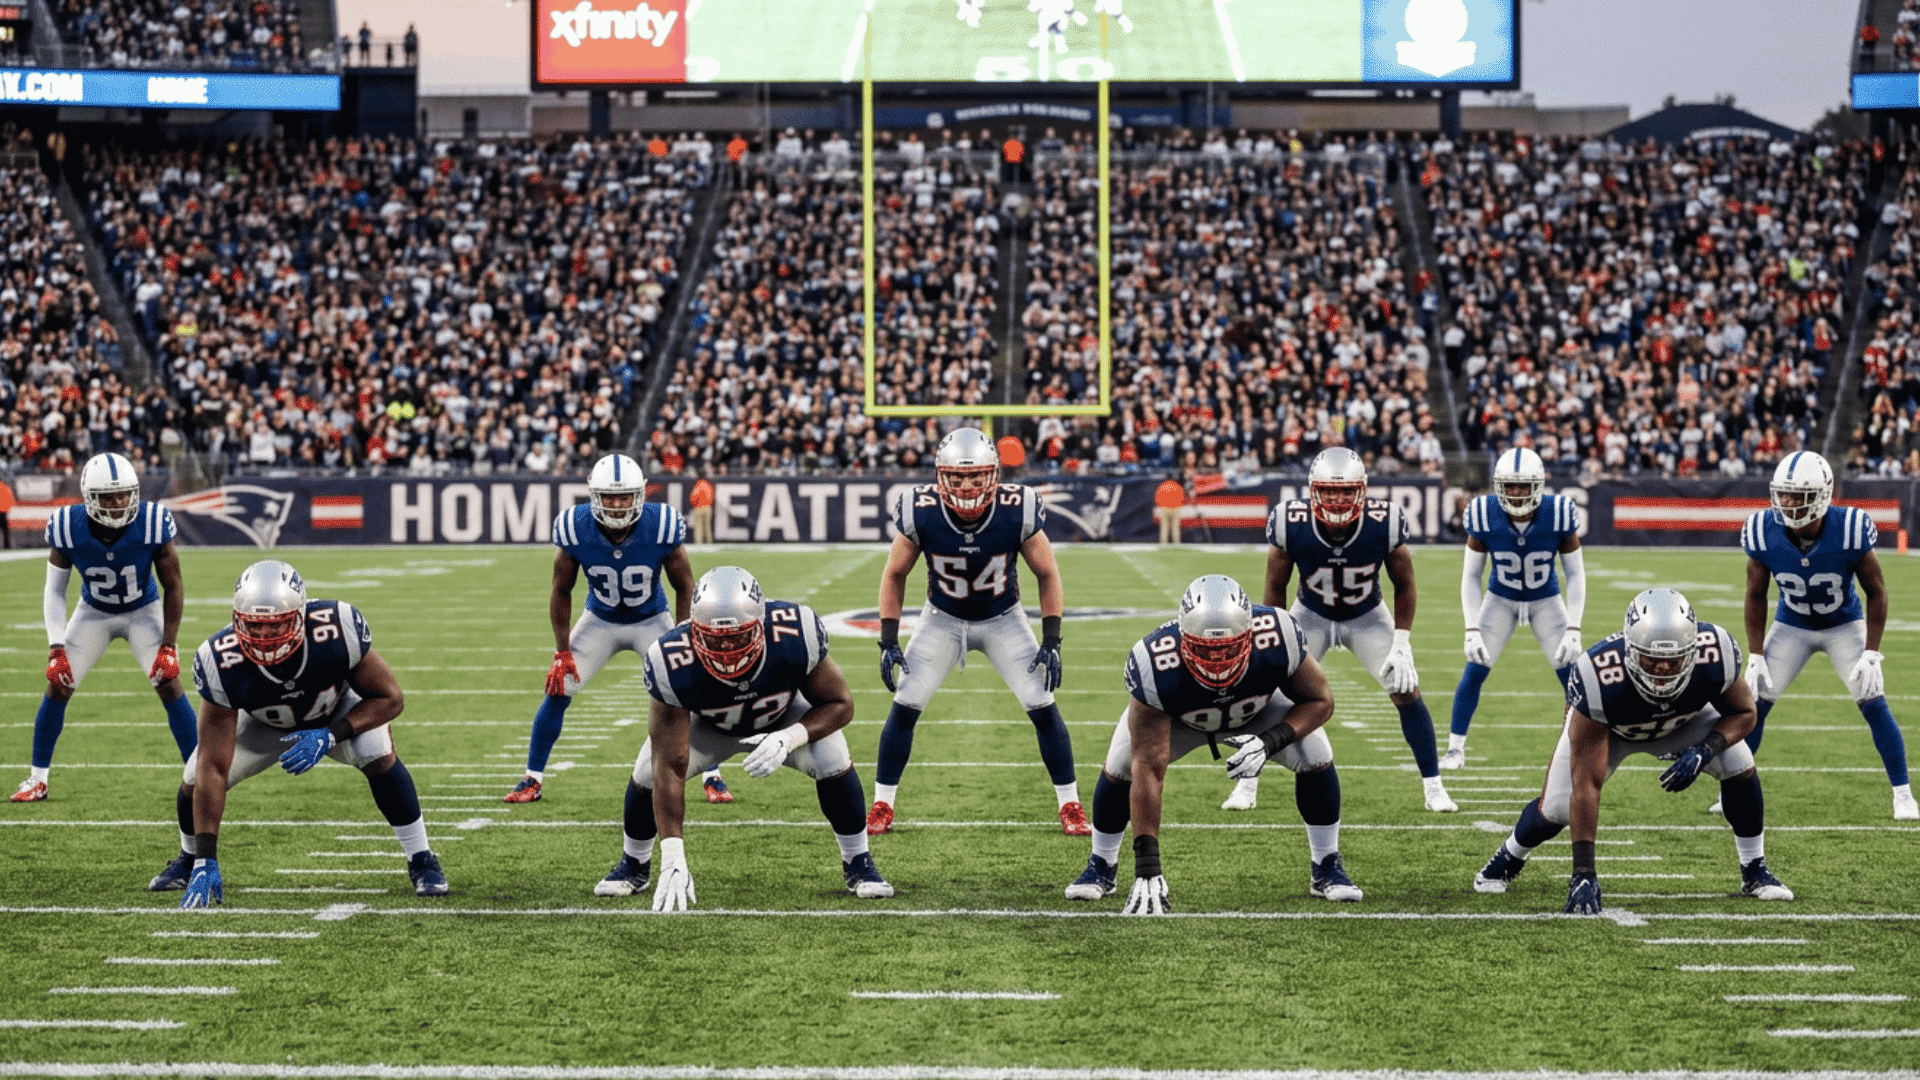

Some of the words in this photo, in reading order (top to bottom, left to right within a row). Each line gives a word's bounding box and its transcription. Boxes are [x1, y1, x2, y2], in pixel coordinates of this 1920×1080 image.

[550, 1, 679, 47] xfinity
[0, 72, 83, 101] Y.COM
[85, 565, 143, 604] 21
[588, 565, 653, 607] 39
[931, 552, 1008, 598] 54
[1306, 563, 1376, 606] 45
[1493, 551, 1553, 590] 26
[1775, 572, 1844, 615] 23
[309, 608, 338, 643] 94
[771, 608, 799, 643] 72
[1252, 614, 1280, 650] 98
[214, 633, 244, 669] 94
[663, 633, 694, 670] 72
[1151, 635, 1180, 671] 98
[1695, 631, 1720, 664] 58
[1593, 650, 1625, 685] 58
[251, 684, 337, 728] 94
[700, 691, 792, 731] 72
